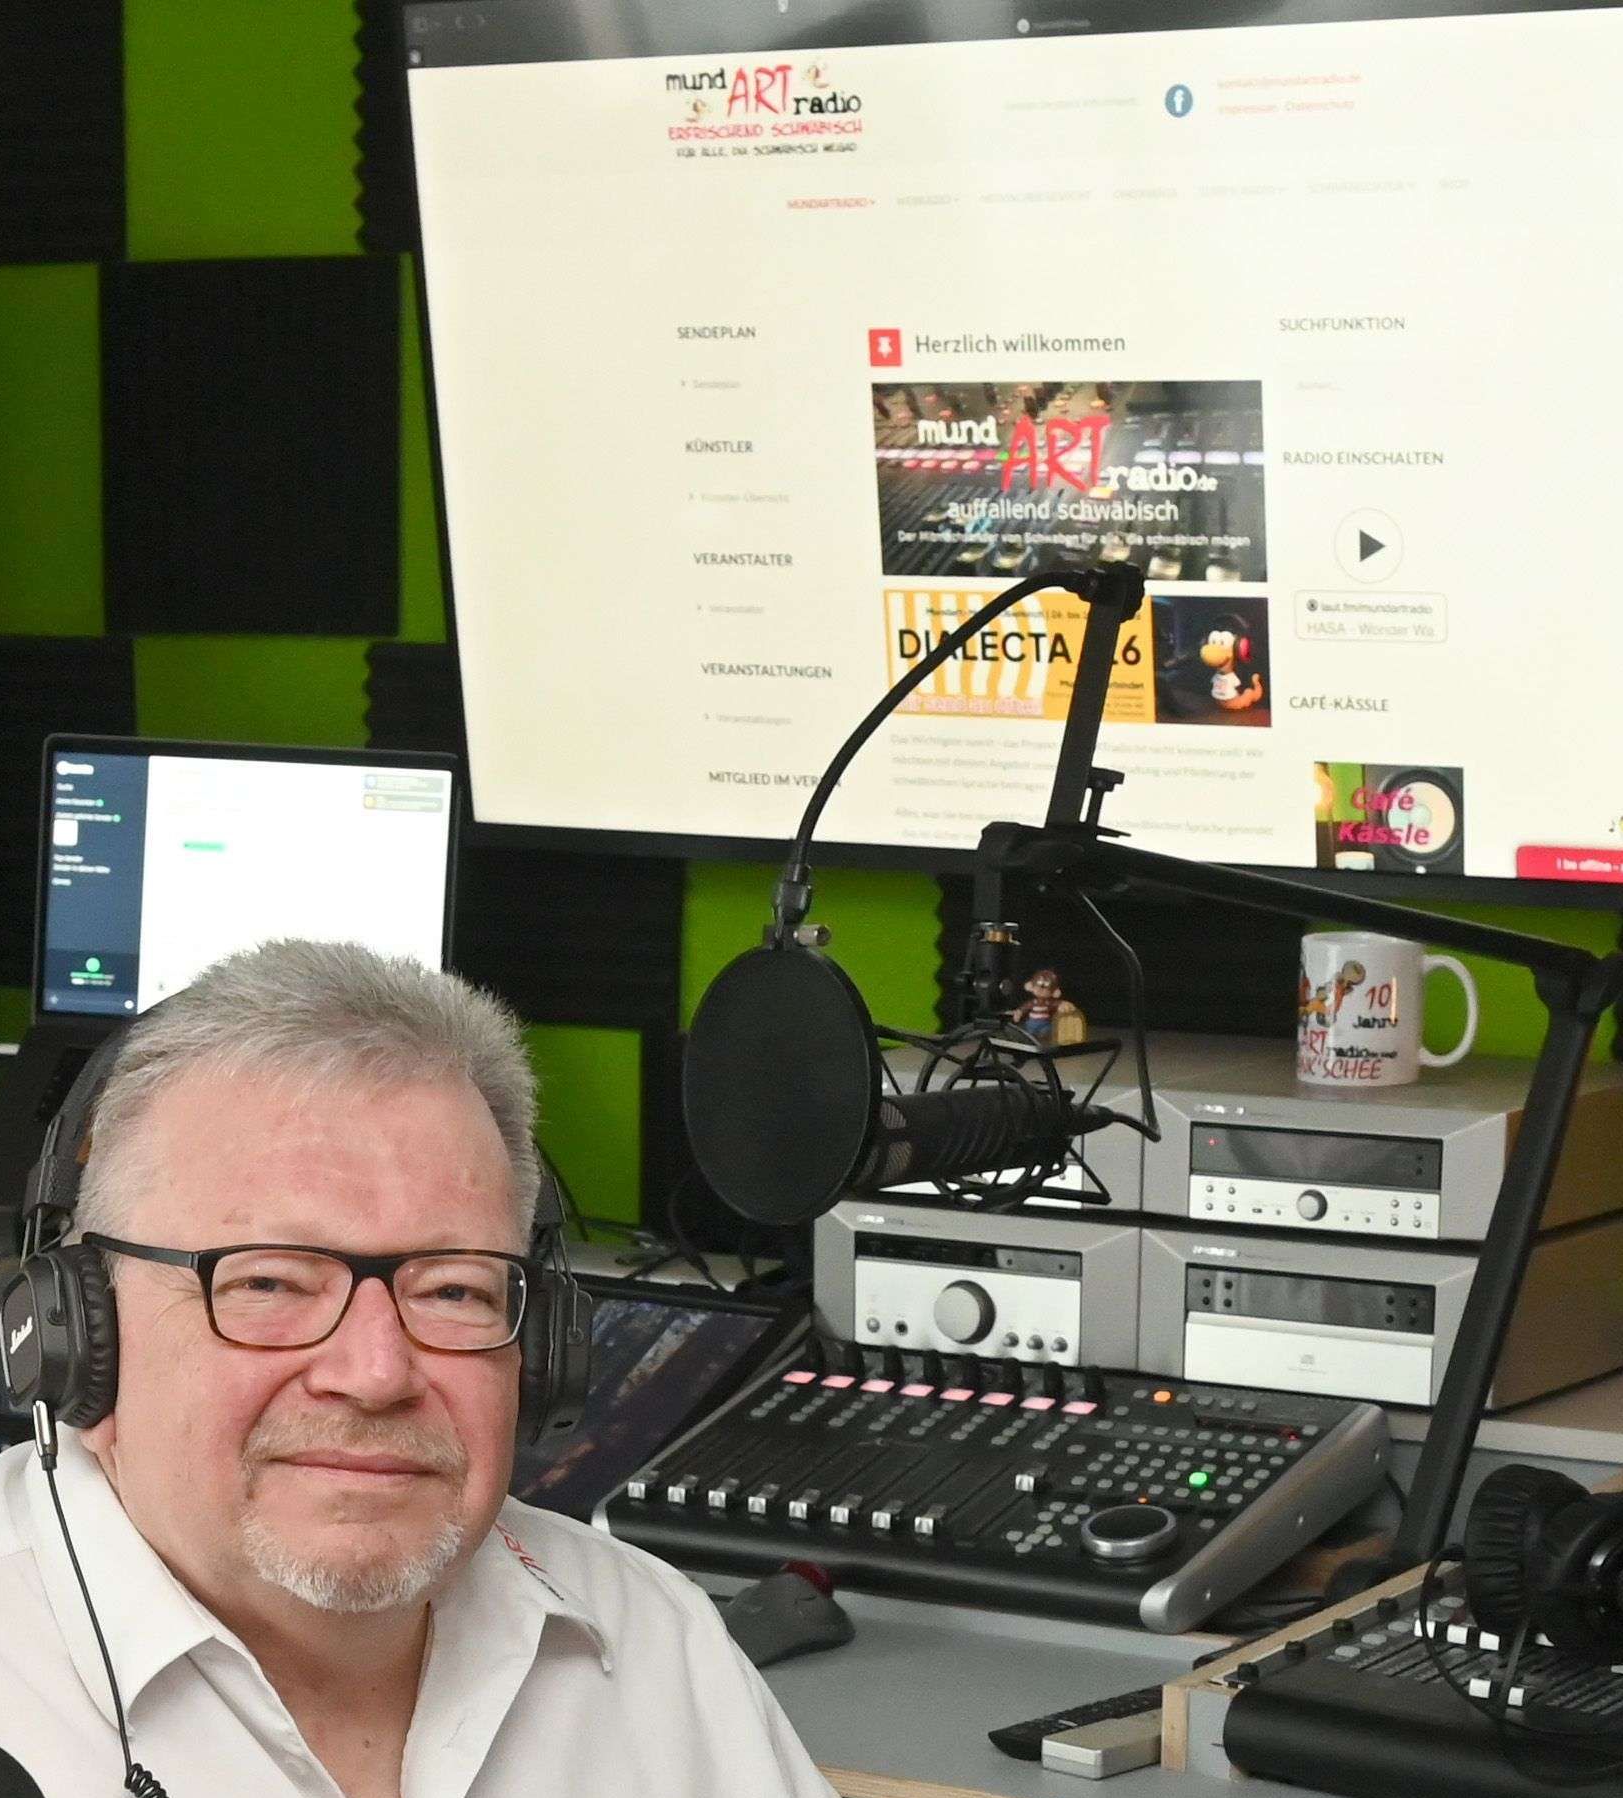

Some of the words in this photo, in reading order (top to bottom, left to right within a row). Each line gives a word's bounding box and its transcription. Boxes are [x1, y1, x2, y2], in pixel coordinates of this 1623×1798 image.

[666, 67, 727, 91] mund
[727, 64, 792, 116] ART
[793, 92, 862, 115] radio
[676, 325, 757, 340] SENDEPLAN
[1278, 316, 1406, 332] SUCHFUNKTION
[915, 332, 997, 355] Herzlich
[1003, 333, 1127, 354] willkommen
[684, 437, 754, 454] KÜNSTLER
[917, 415, 1000, 445] mund
[1001, 414, 1112, 492] ART
[1282, 450, 1333, 465] RADIO
[1336, 450, 1445, 466] EINSCHALTEN
[946, 498, 1051, 521] auffallend
[1057, 499, 1180, 522] schwäbisch
[692, 551, 794, 567] VERANSTALTER
[897, 628, 1073, 666] DIALECTA
[700, 662, 834, 680] VERANSTALTUNGEN
[1288, 694, 1391, 713] CAFÉ-KÄSSLE
[708, 771, 771, 787] MITGLIED
[774, 774, 790, 786] IM
[1351, 785, 1416, 813] Café
[1338, 820, 1431, 847] Kässle
[1365, 982, 1392, 1010] 10
